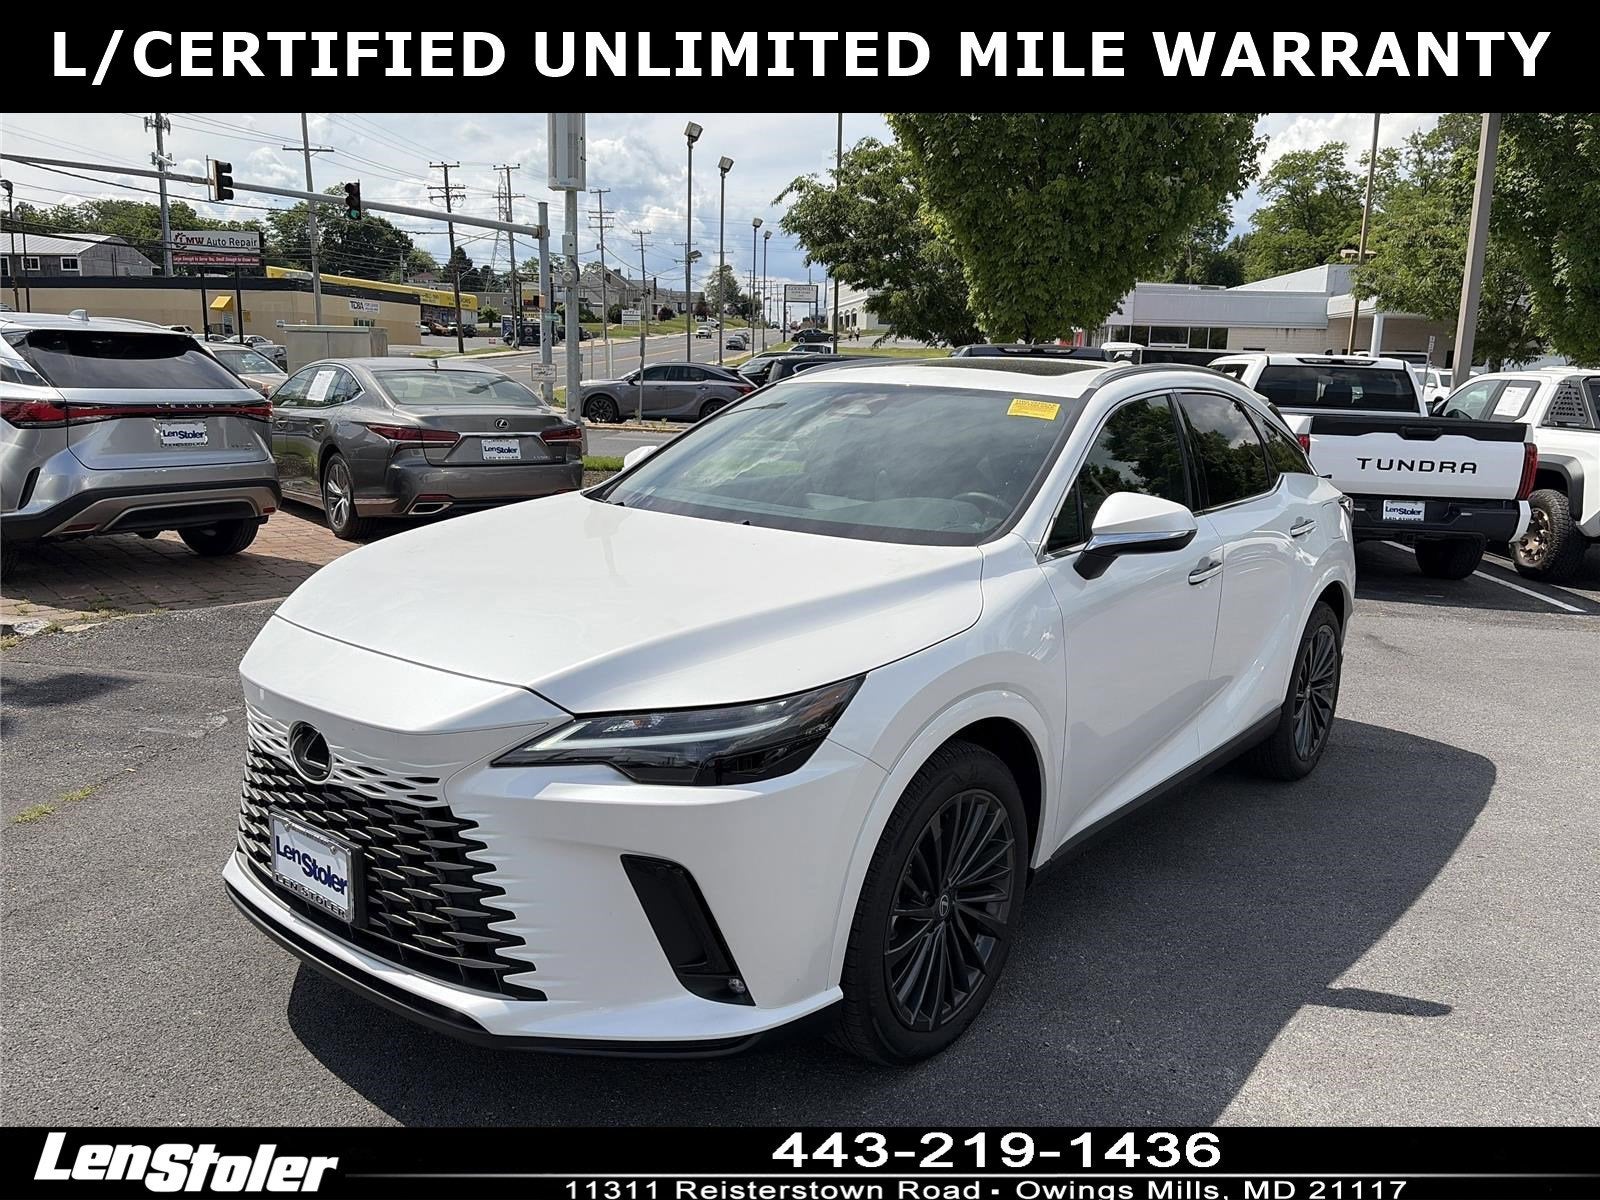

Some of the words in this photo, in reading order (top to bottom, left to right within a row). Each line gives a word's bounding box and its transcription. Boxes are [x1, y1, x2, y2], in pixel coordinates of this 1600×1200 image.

[207, 238, 227, 247] Auto
[229, 237, 257, 248] Repair
[1356, 457, 1478, 475] TUNDRA
[274, 873, 298, 892] LEN
[301, 886, 346, 918] STOLER
